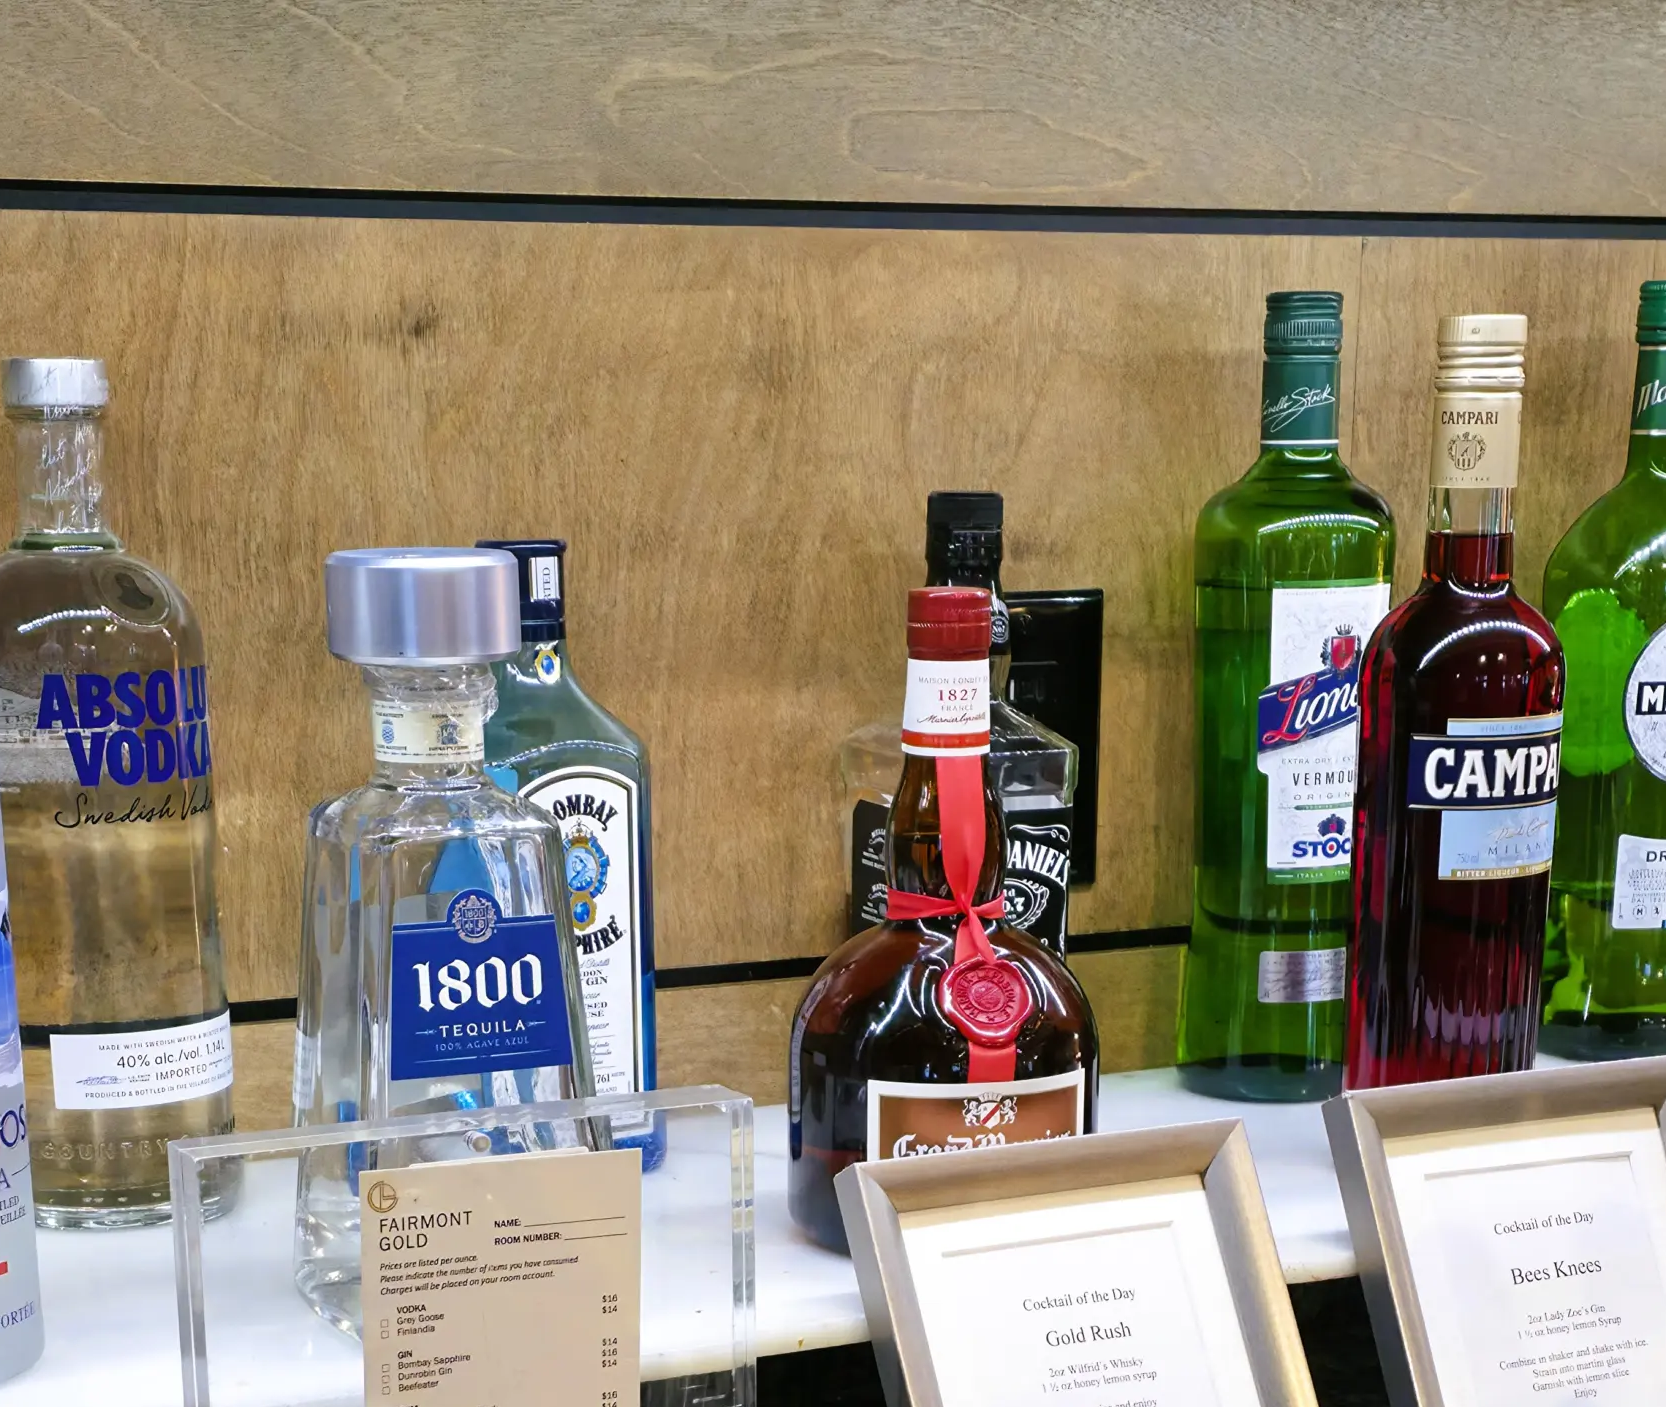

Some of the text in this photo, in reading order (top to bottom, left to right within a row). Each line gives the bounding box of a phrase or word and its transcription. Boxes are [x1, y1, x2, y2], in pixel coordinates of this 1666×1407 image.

[1441, 411, 1499, 425] CAMPARI
[37, 665, 207, 729] ABSOLU
[938, 688, 978, 701] 1827
[65, 721, 212, 787] VODKA
[1293, 769, 1353, 787] VERMOU
[1424, 742, 1559, 800] CAMPA
[55, 793, 176, 828] Swedish
[553, 794, 619, 832] OMBAY
[1292, 840, 1351, 858] STOC
[412, 953, 543, 1012] 1800
[586, 976, 608, 986] GIN
[439, 1019, 527, 1039] TEQUILA
[435, 1041, 463, 1052] 100%
[466, 1039, 501, 1050] AGAVE
[116, 1055, 151, 1069] 40%
[155, 1046, 203, 1065] alc./vol.
[155, 1063, 207, 1081] IMPORTED
[85, 1090, 127, 1099] PRODUCED
[379, 1210, 473, 1233] FAIRMONT
[494, 1219, 522, 1229] NAME:
[1494, 1211, 1594, 1236] Cocktail Day
[379, 1233, 428, 1251] GOLD
[494, 1232, 562, 1246] ROOM NUMBER:
[380, 1262, 402, 1271] Prices
[1510, 1258, 1602, 1286] Bees Knees
[380, 1274, 403, 1283] Please
[380, 1285, 413, 1296] Charges
[1023, 1287, 1136, 1312] Cocktail Day
[396, 1304, 426, 1314] VODKA
[1544, 1310, 1564, 1322] Lady
[1590, 1303, 1606, 1314] Gin
[397, 1313, 445, 1326] Grey Goose
[1598, 1315, 1622, 1328] Syrup
[397, 1325, 435, 1336] Finlandia
[1046, 1321, 1132, 1347] Gold Rush
[397, 1350, 413, 1360] GIN
[398, 1354, 471, 1370] Bombay Sapphire
[398, 1370, 436, 1381] Dunrobin
[1049, 1367, 1065, 1378] 2oz
[1110, 1356, 1143, 1369] Whisky
